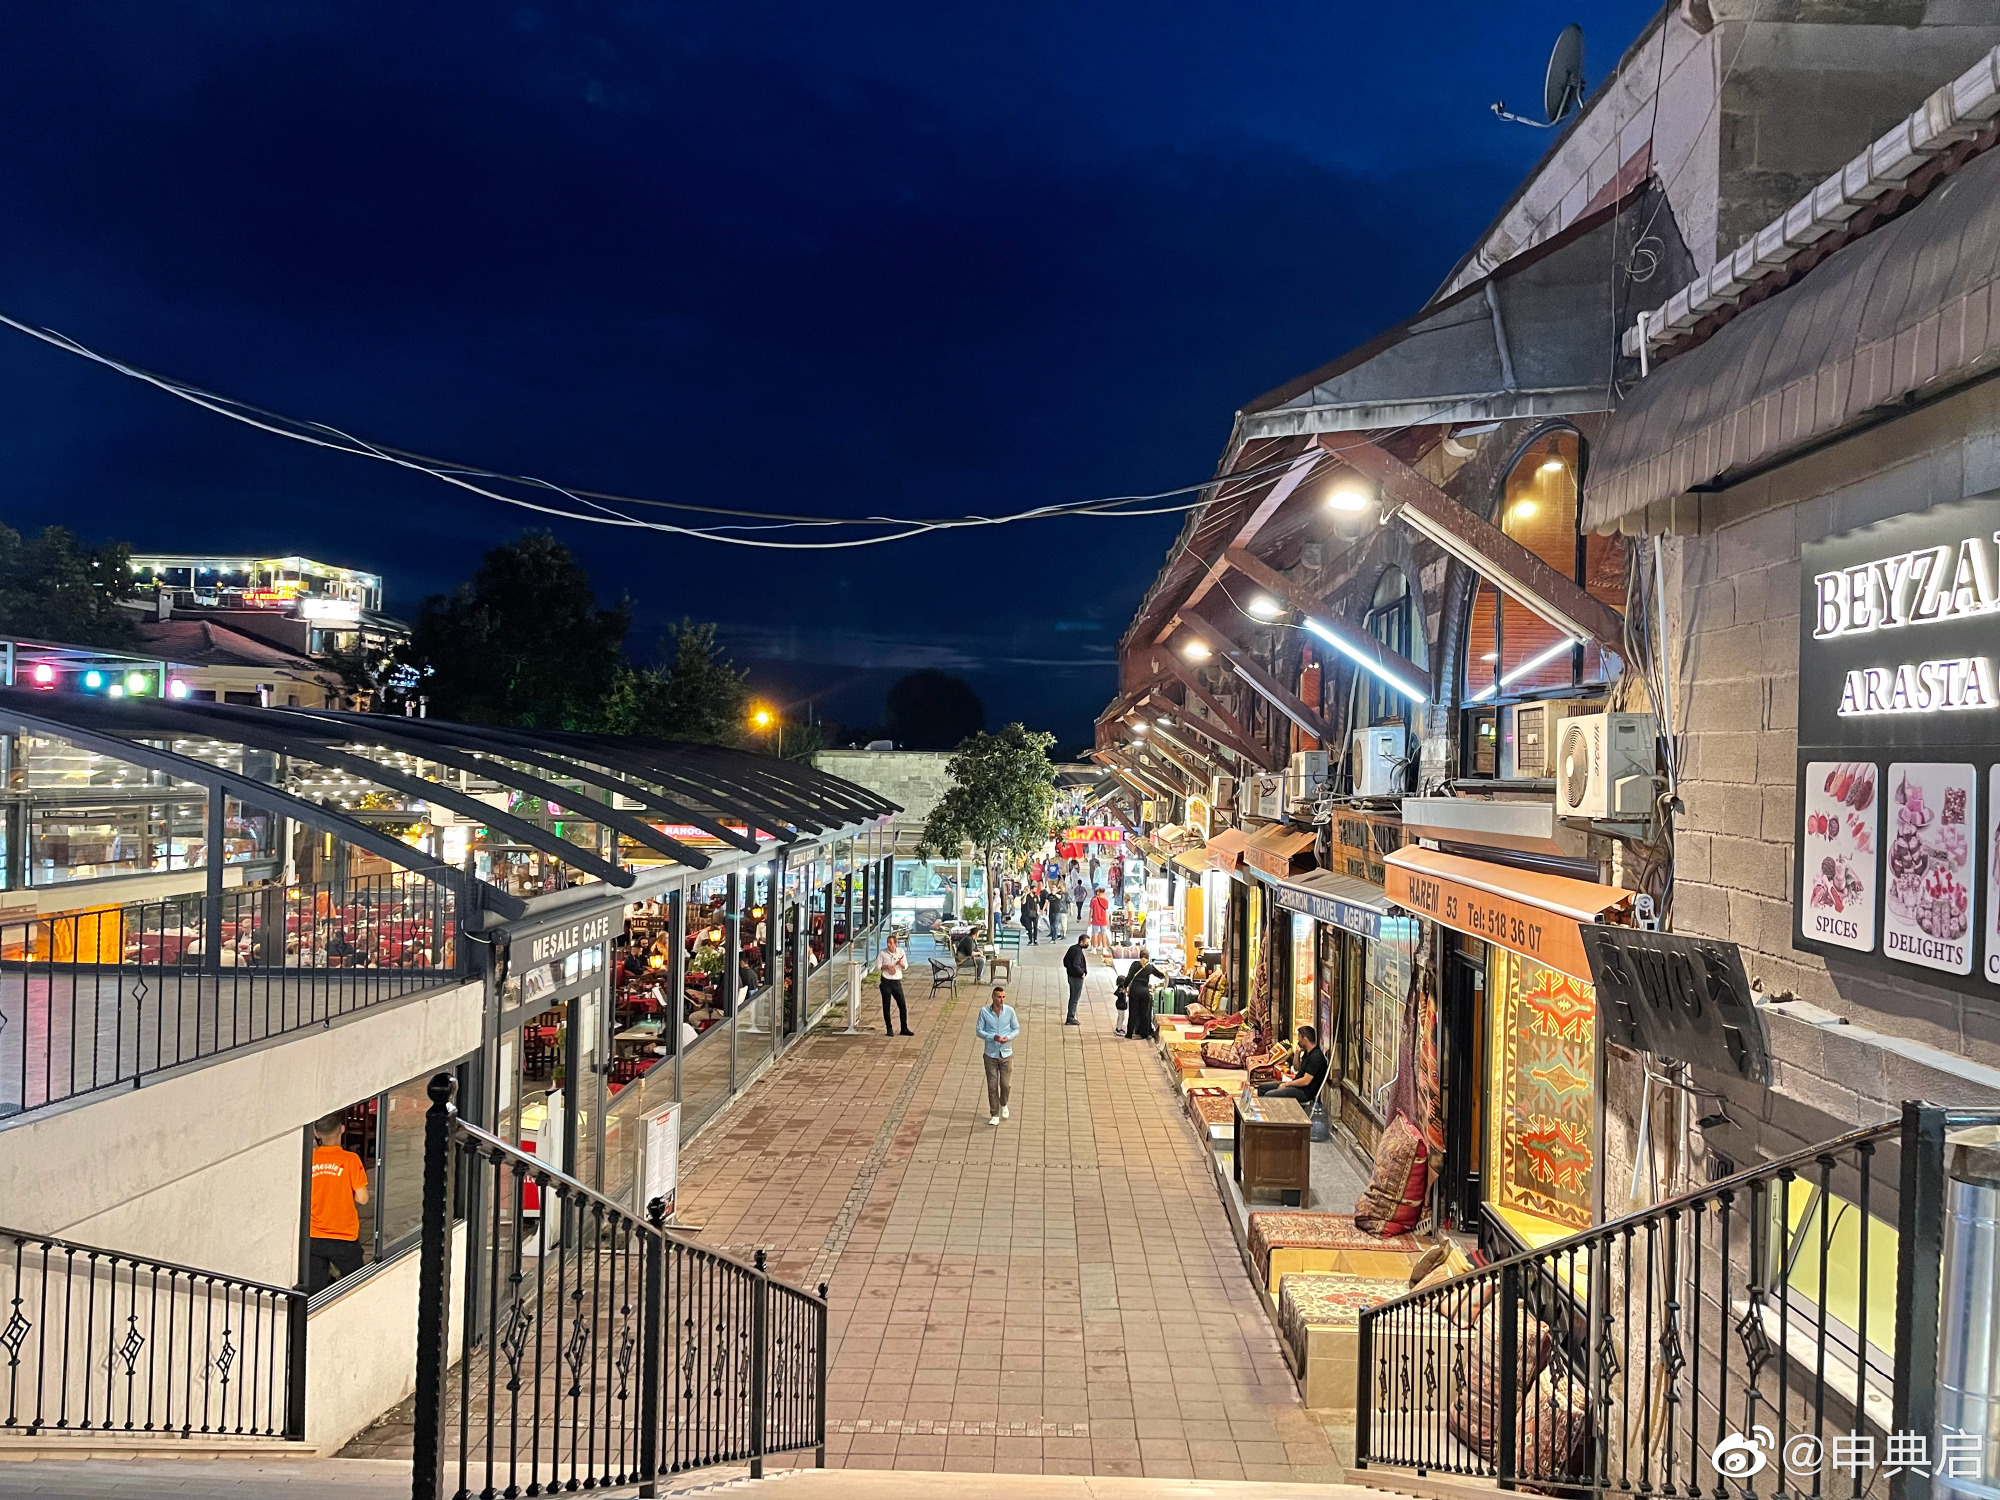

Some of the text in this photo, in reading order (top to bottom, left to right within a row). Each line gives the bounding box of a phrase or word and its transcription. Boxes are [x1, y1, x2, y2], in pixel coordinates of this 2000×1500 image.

[1814, 531, 2000, 640] BEYZA
[1837, 657, 1997, 716] ARASTA
[1312, 896, 1339, 923] TRAVEL
[1343, 906, 1376, 936] AGENCY
[1409, 876, 1542, 953] HAREM 53 Tel: 518 36 07
[1816, 915, 1858, 940] SPICES
[532, 916, 609, 963] MEŞALE CAFE
[1888, 931, 1964, 966] DELIGHTS
